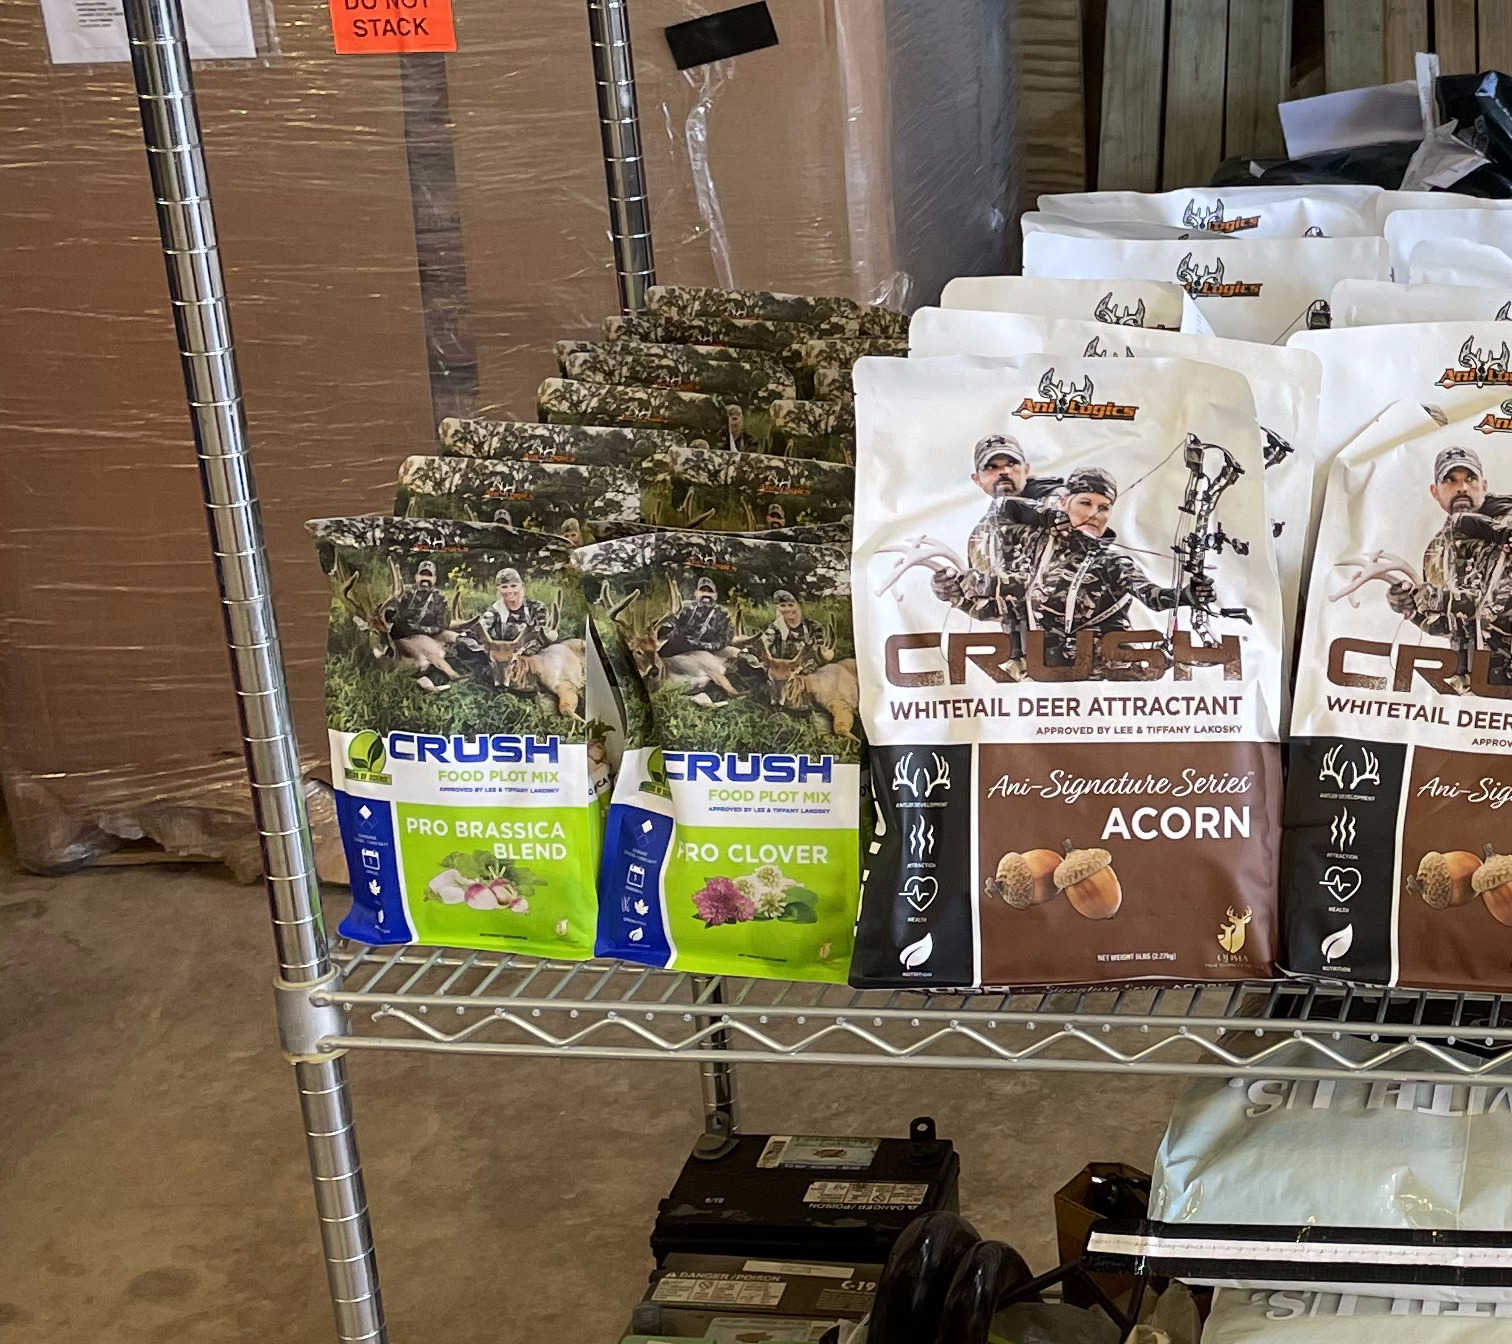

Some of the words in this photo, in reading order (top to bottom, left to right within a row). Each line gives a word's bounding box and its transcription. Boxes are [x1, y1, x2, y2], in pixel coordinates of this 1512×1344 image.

[353, 17, 430, 38] STACK
[885, 630, 1243, 686] CRUSH
[890, 697, 1011, 721] WHITETAIL
[1018, 696, 1082, 718] DEER
[1088, 696, 1243, 717] ATTRACTANT
[1326, 695, 1450, 727] WHITETAIL
[1036, 725, 1094, 735] APPROVED
[1097, 726, 1111, 735] BY
[1114, 725, 1133, 735] LEE
[1136, 725, 1143, 734] &
[1146, 725, 1190, 734] TIFFANY
[1193, 724, 1243, 734] LAKOSKY
[389, 733, 559, 764] CRUSH
[438, 770, 486, 783] FOOD
[489, 770, 533, 783] PLOT
[537, 771, 560, 783] MIX
[663, 753, 832, 783] CRUSH
[708, 789, 754, 801] FOOD
[759, 791, 798, 803] PLOT
[803, 792, 831, 803] MIX
[988, 769, 1171, 804] Ani-Signature
[1171, 767, 1251, 797] Series
[406, 816, 449, 837] PRO
[455, 819, 566, 841] BRASSICA
[1101, 806, 1251, 841] ACORN
[493, 840, 567, 860] BLEND
[728, 844, 828, 864] CLOVER
[680, 1272, 730, 1280] DANGER
